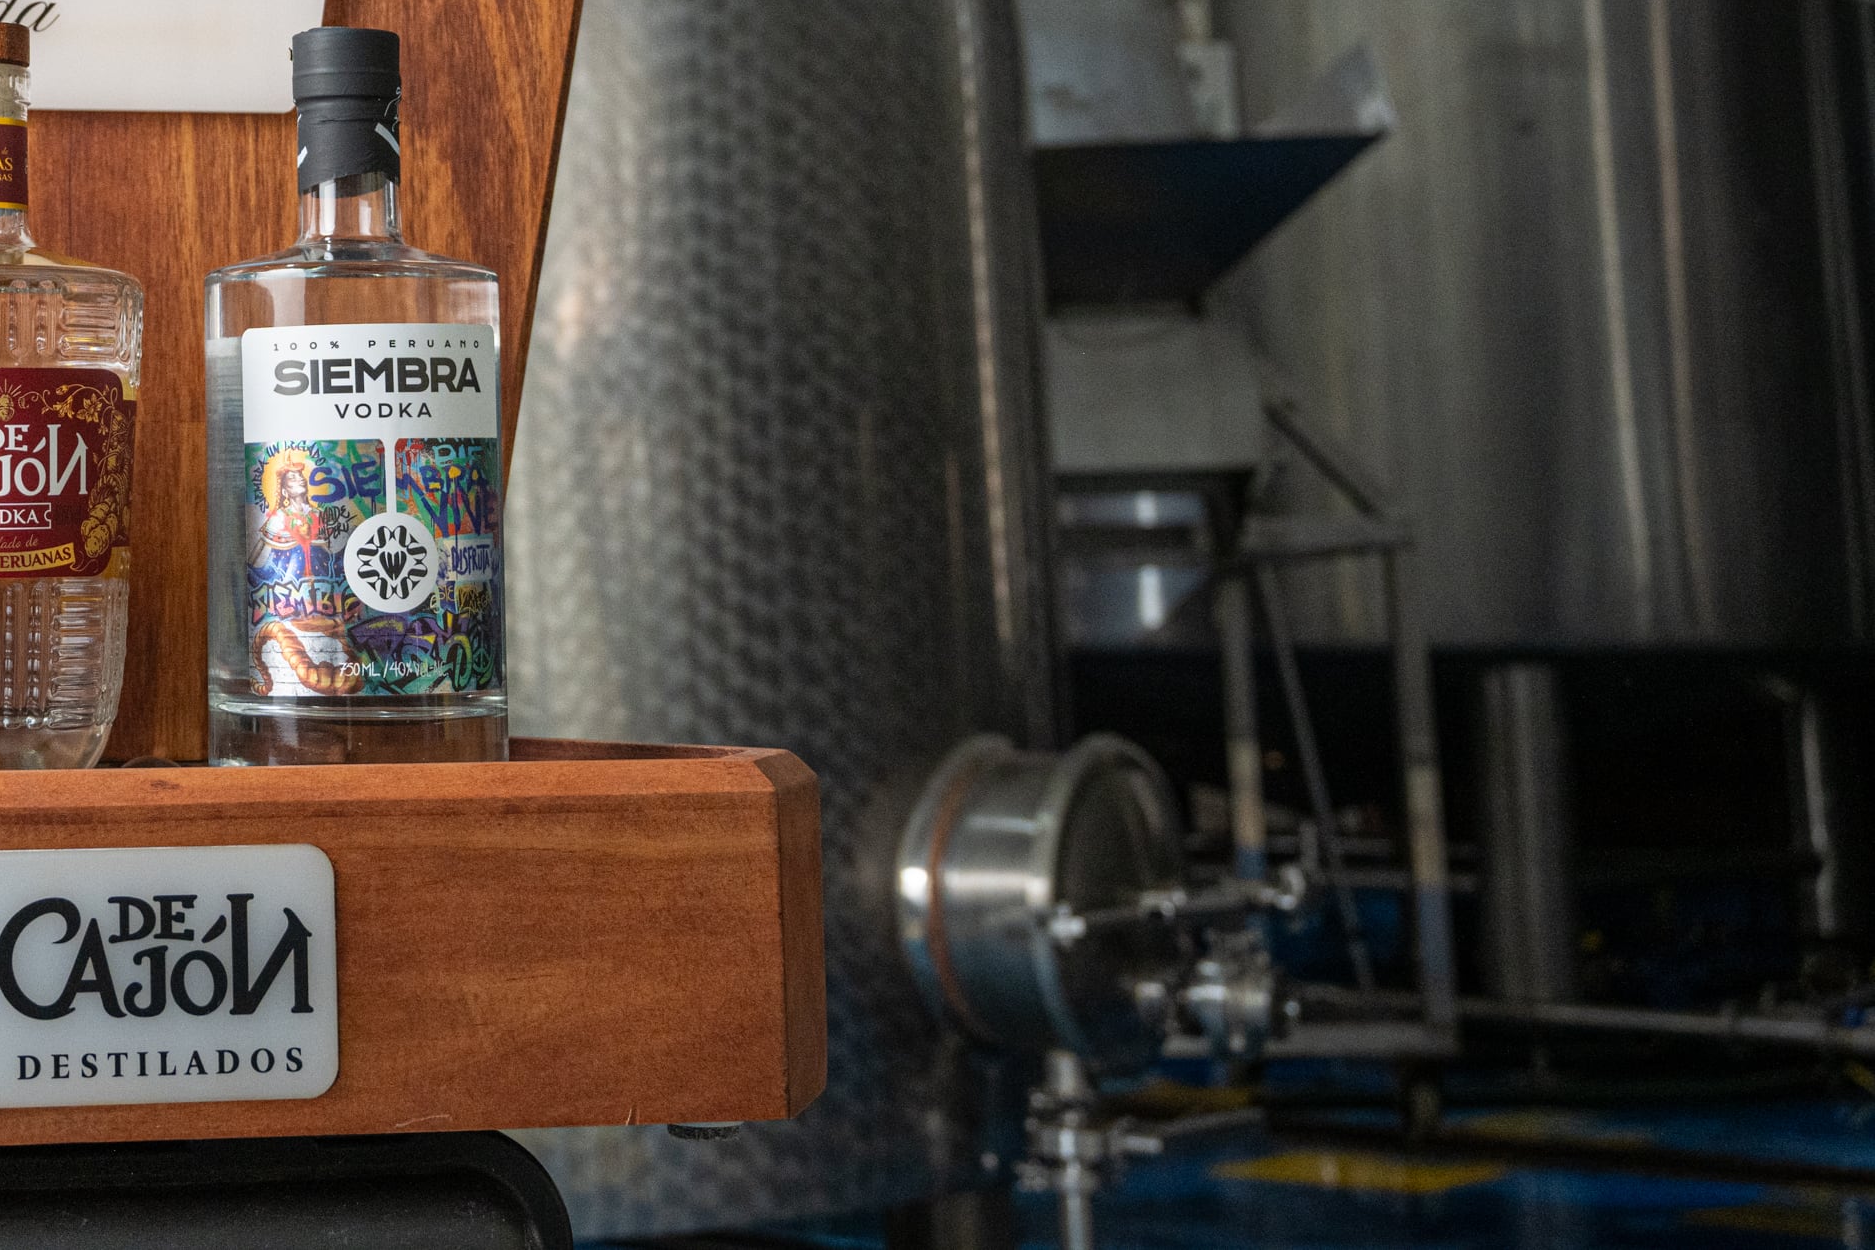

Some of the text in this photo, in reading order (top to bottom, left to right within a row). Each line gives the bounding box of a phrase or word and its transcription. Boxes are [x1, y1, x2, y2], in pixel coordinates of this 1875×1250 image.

[273, 340, 480, 351] 100% PERUANO
[273, 357, 482, 396] SIEMBRA
[334, 402, 433, 419] VODKA
[25, 534, 40, 548] de
[108, 894, 198, 944] DE
[17, 1046, 305, 1081] DESTILADOS
